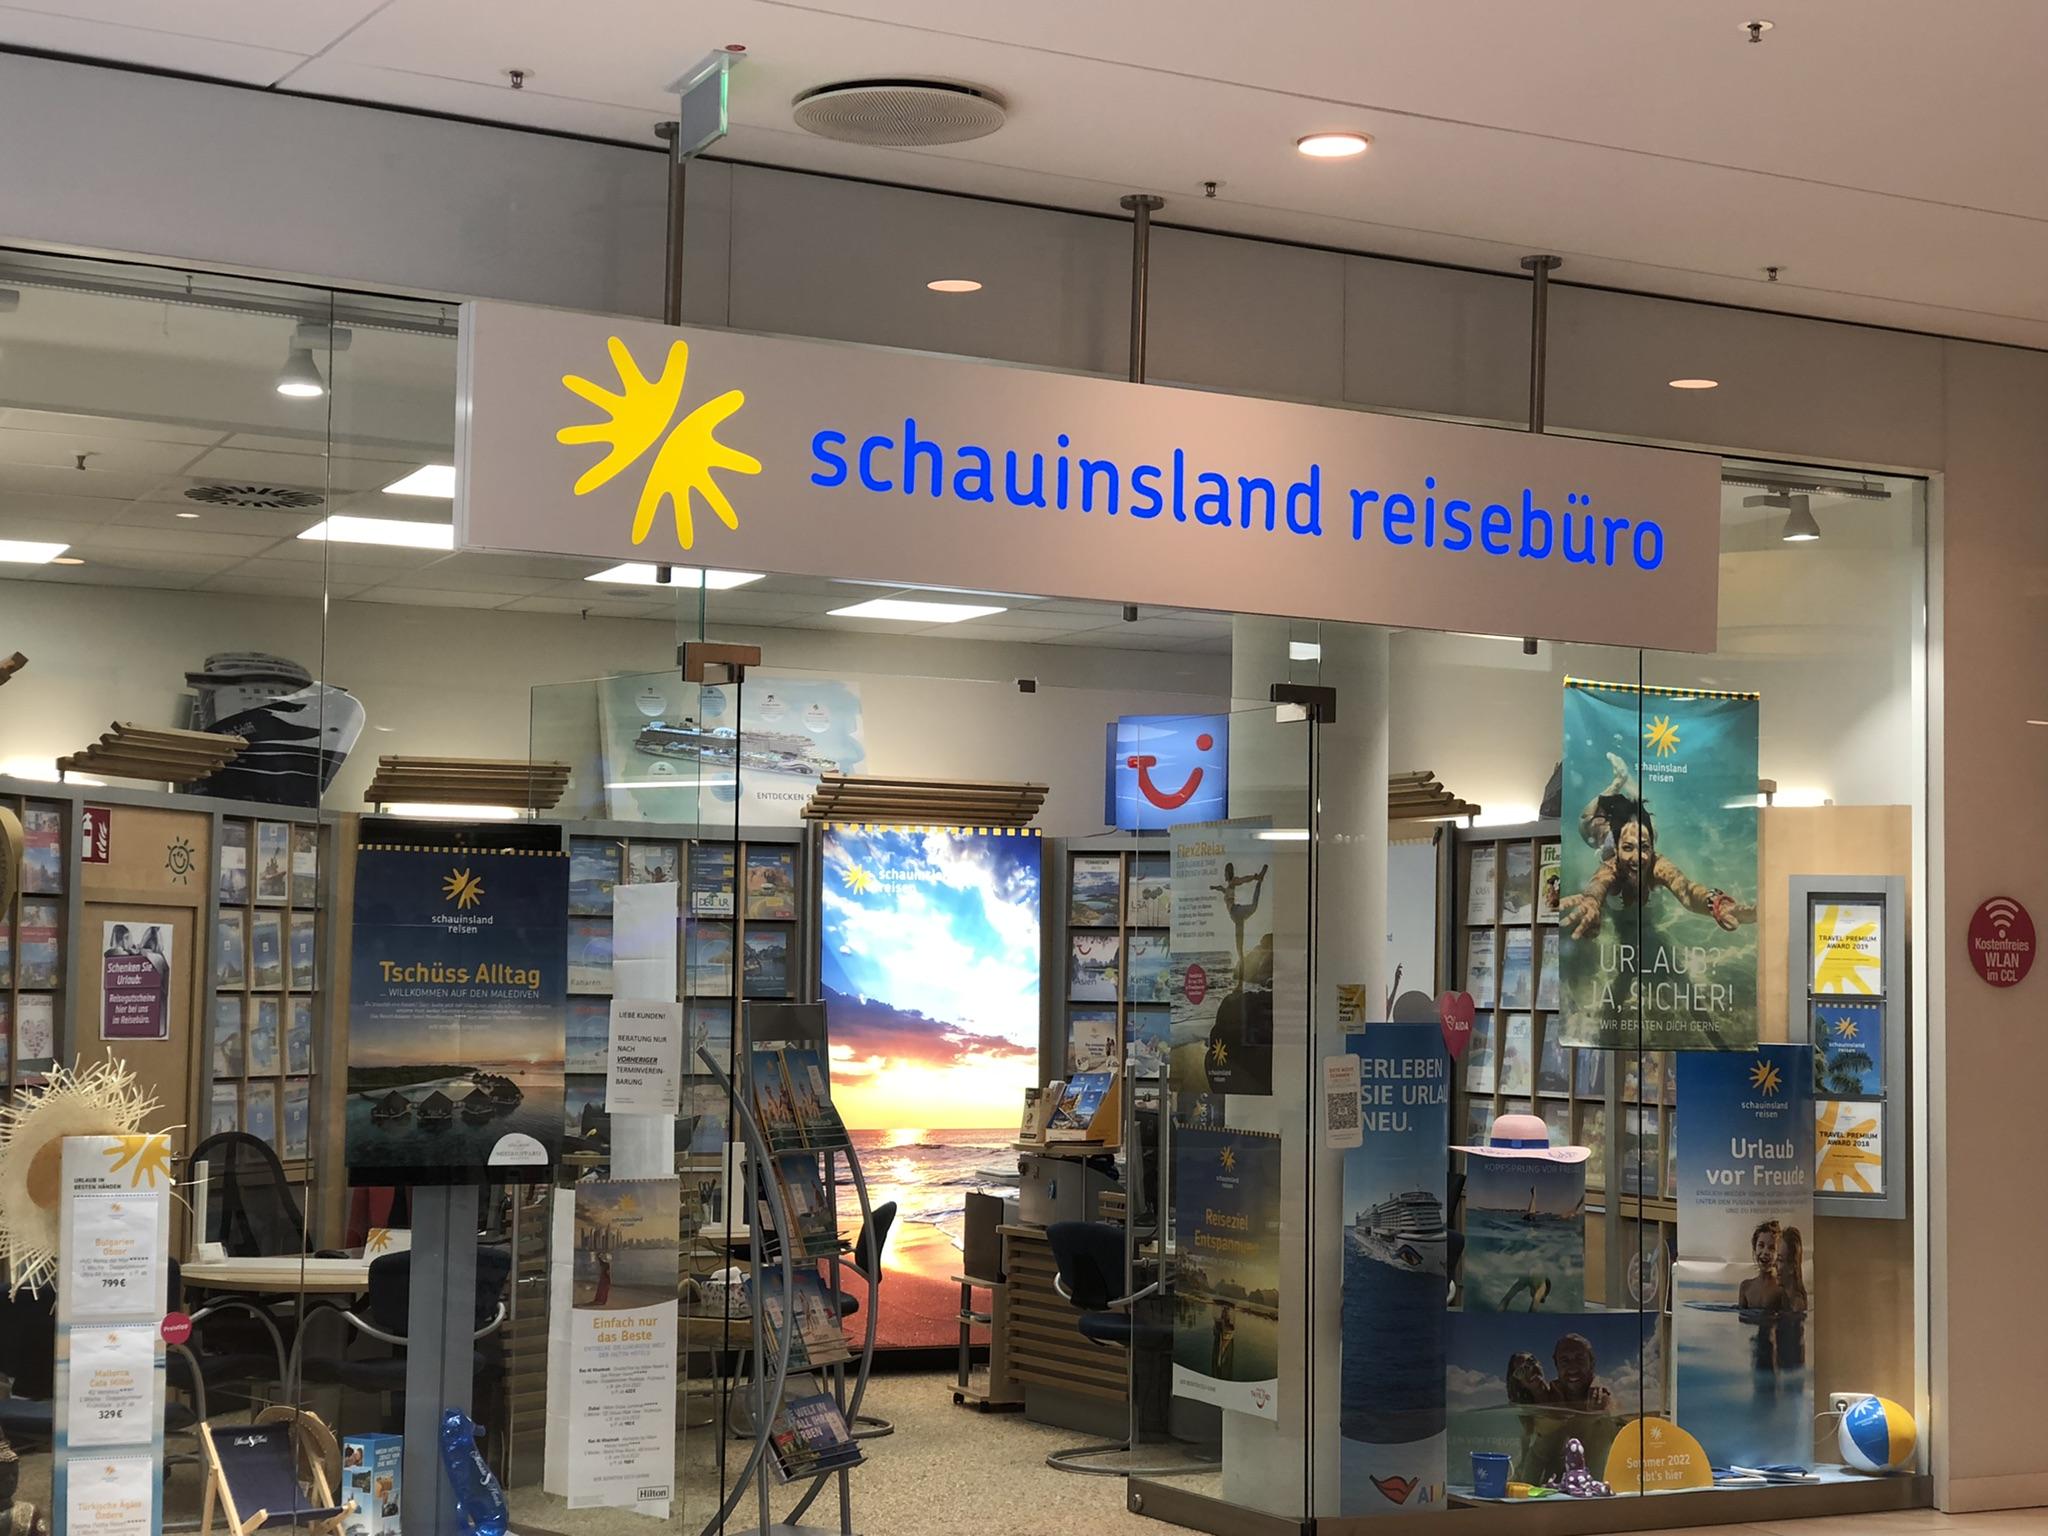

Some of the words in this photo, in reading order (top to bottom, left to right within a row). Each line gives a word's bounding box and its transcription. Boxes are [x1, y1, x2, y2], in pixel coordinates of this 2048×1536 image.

[811, 420, 1321, 536] schauinsland
[1352, 477, 1663, 570] reisebüro
[1634, 762, 1688, 774] schauinsland
[1648, 773, 1674, 783] reisen
[756, 792, 804, 801] ENTDECKEN
[431, 914, 494, 926] schauinsland
[447, 924, 478, 934] reisen
[1975, 937, 2030, 951] Kostenfreies
[1985, 952, 2020, 968] WLAN
[107, 962, 141, 974] Schenken
[141, 961, 153, 972] Sie
[379, 961, 470, 984] Tschüss
[475, 963, 542, 990] Alltag
[1987, 968, 1998, 981] im
[2000, 969, 2018, 982] CCL
[388, 988, 449, 998] WILLKOMMEN
[450, 989, 468, 998] AUF
[469, 989, 488, 999] DEN
[490, 989, 540, 1000] MALEDIVEN
[1589, 980, 1622, 1013] JA,
[1629, 981, 1734, 1013] SICHER!
[618, 1011, 635, 1019] LIEBE
[636, 1012, 666, 1020] KUNDEN!
[1600, 1019, 1618, 1030] WIR
[1665, 1020, 1687, 1032] DICH
[1690, 1021, 1720, 1032] GERNE
[617, 1034, 652, 1043] BERATUNG
[617, 1045, 636, 1053] NACH
[1828, 1041, 1866, 1049] schauinsland
[617, 1055, 658, 1065] VORHERIGER
[1360, 1058, 1443, 1079] ERLEBEN
[615, 1078, 643, 1086] BARUNG
[1360, 1084, 1394, 1105] SIE
[1741, 1101, 1789, 1109] schauinsland
[1755, 1110, 1778, 1118] reisen
[1361, 1111, 1414, 1132] NEU.
[1819, 1131, 1846, 1139] TRAVEL
[1731, 1137, 1794, 1159] Urlaub
[1705, 1168, 1746, 1185] vor
[1753, 1164, 1805, 1186] Freude
[1205, 1208, 1249, 1232] Reiseziel
[592, 1316, 635, 1329] Einfach
[638, 1317, 658, 1327] nur
[597, 1332, 617, 1343] das
[621, 1330, 653, 1342] Beste
[1667, 1454, 1691, 1466] 2022
[1665, 1470, 1684, 1481] hier
[640, 1489, 667, 1499] Hilton
